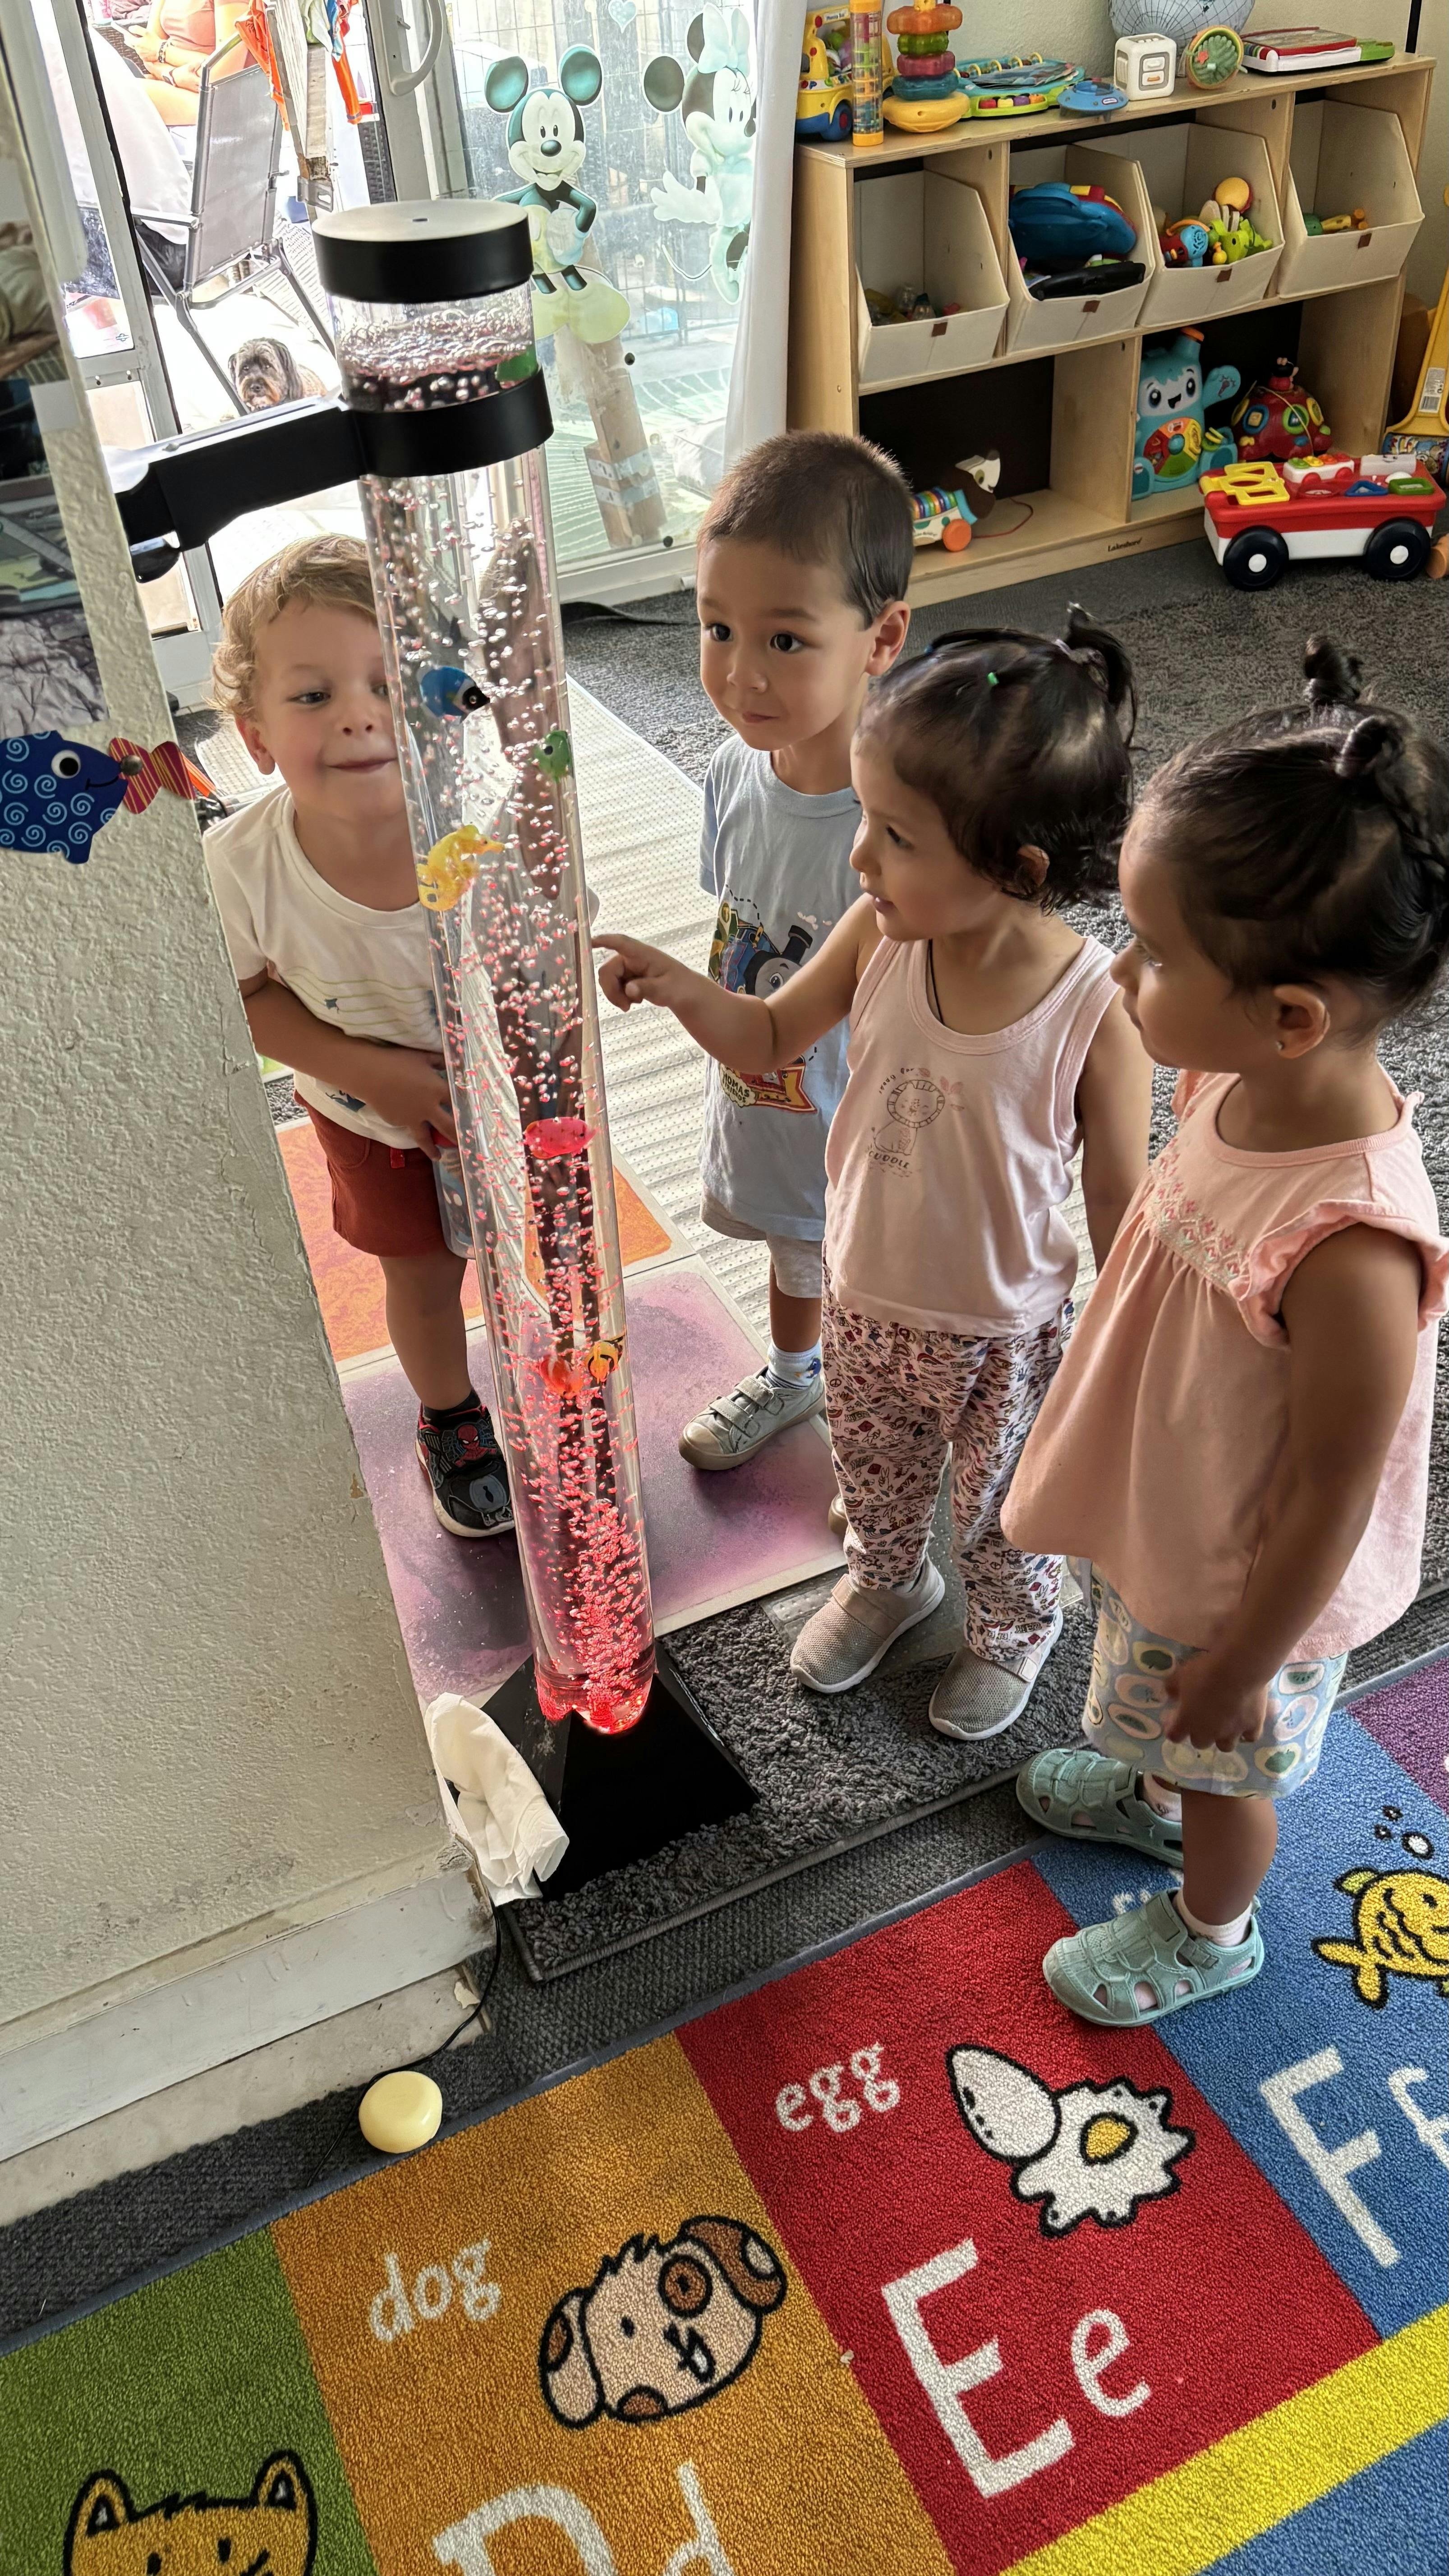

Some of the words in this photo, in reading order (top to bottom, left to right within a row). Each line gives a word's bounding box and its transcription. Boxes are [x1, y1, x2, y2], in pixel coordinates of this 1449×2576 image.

[723, 1072, 750, 1098] HOMAS
[869, 1151, 910, 1169] CUDDLE
[776, 2043, 900, 2133] egg
[370, 2238, 501, 2342] dog
